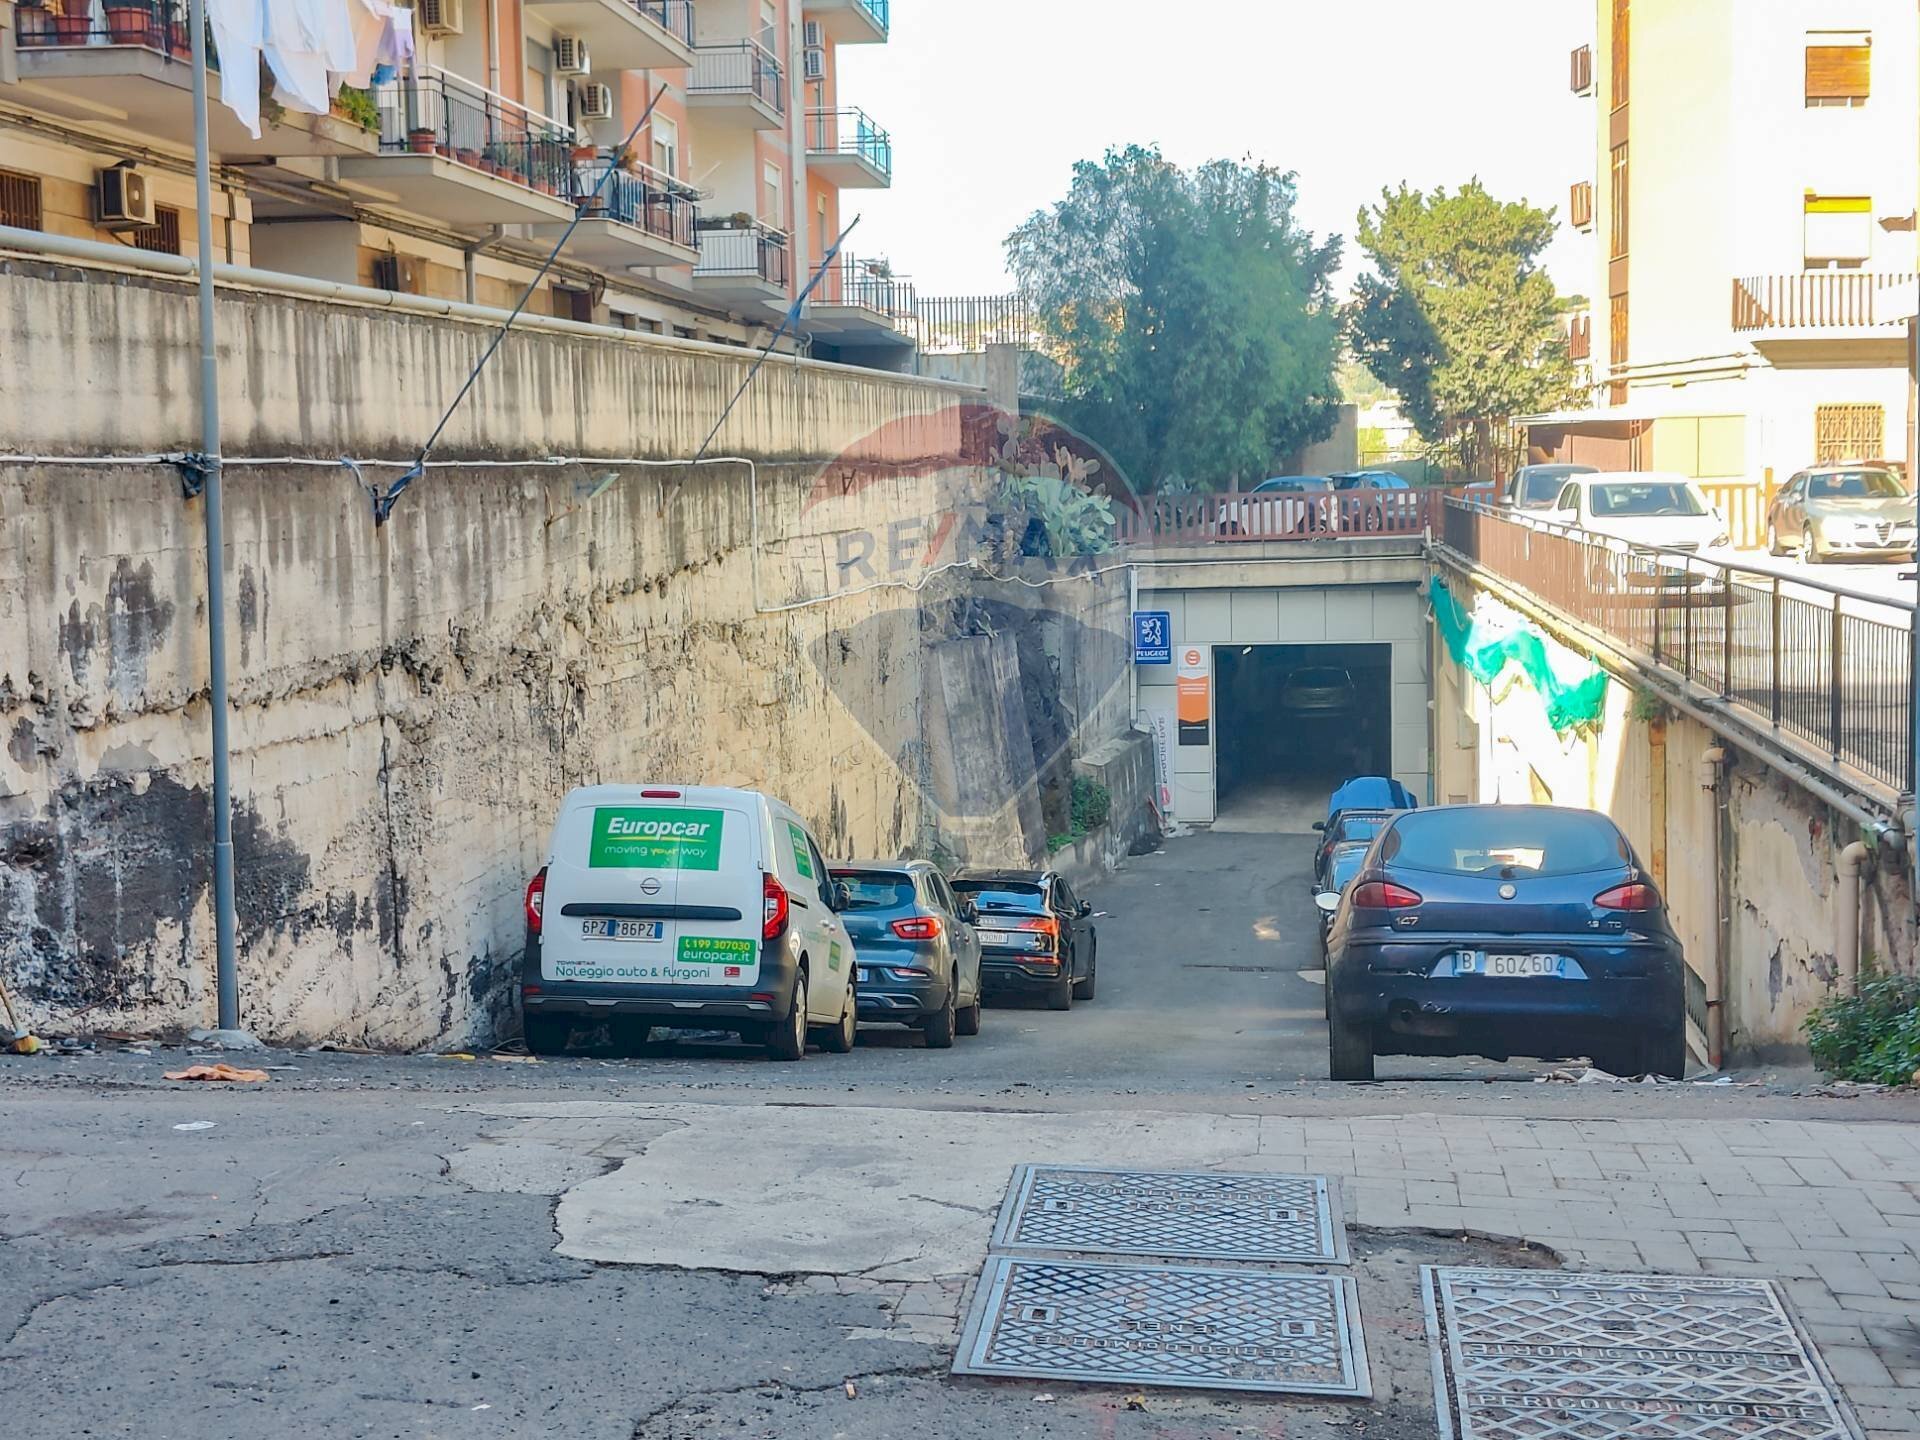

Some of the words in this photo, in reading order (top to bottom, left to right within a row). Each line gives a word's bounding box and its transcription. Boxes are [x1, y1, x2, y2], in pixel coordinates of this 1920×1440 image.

[1136, 650, 1168, 658] PEUGEOT
[607, 817, 711, 841] Europcar
[604, 845, 648, 856] moving
[650, 846, 679, 857] your
[680, 848, 707, 858] way
[1395, 916, 1420, 926] 147
[692, 939, 711, 949] 199
[713, 941, 751, 951] 307030
[683, 950, 750, 962] europcar.it
[555, 965, 614, 979] Noleggio
[616, 966, 648, 977] auto
[650, 967, 659, 977] &
[663, 966, 710, 980] furgoni
[1547, 1289, 1686, 1304] ENEL
[1126, 1321, 1208, 1335] ENEL
[1697, 1403, 1816, 1419] MORTE
